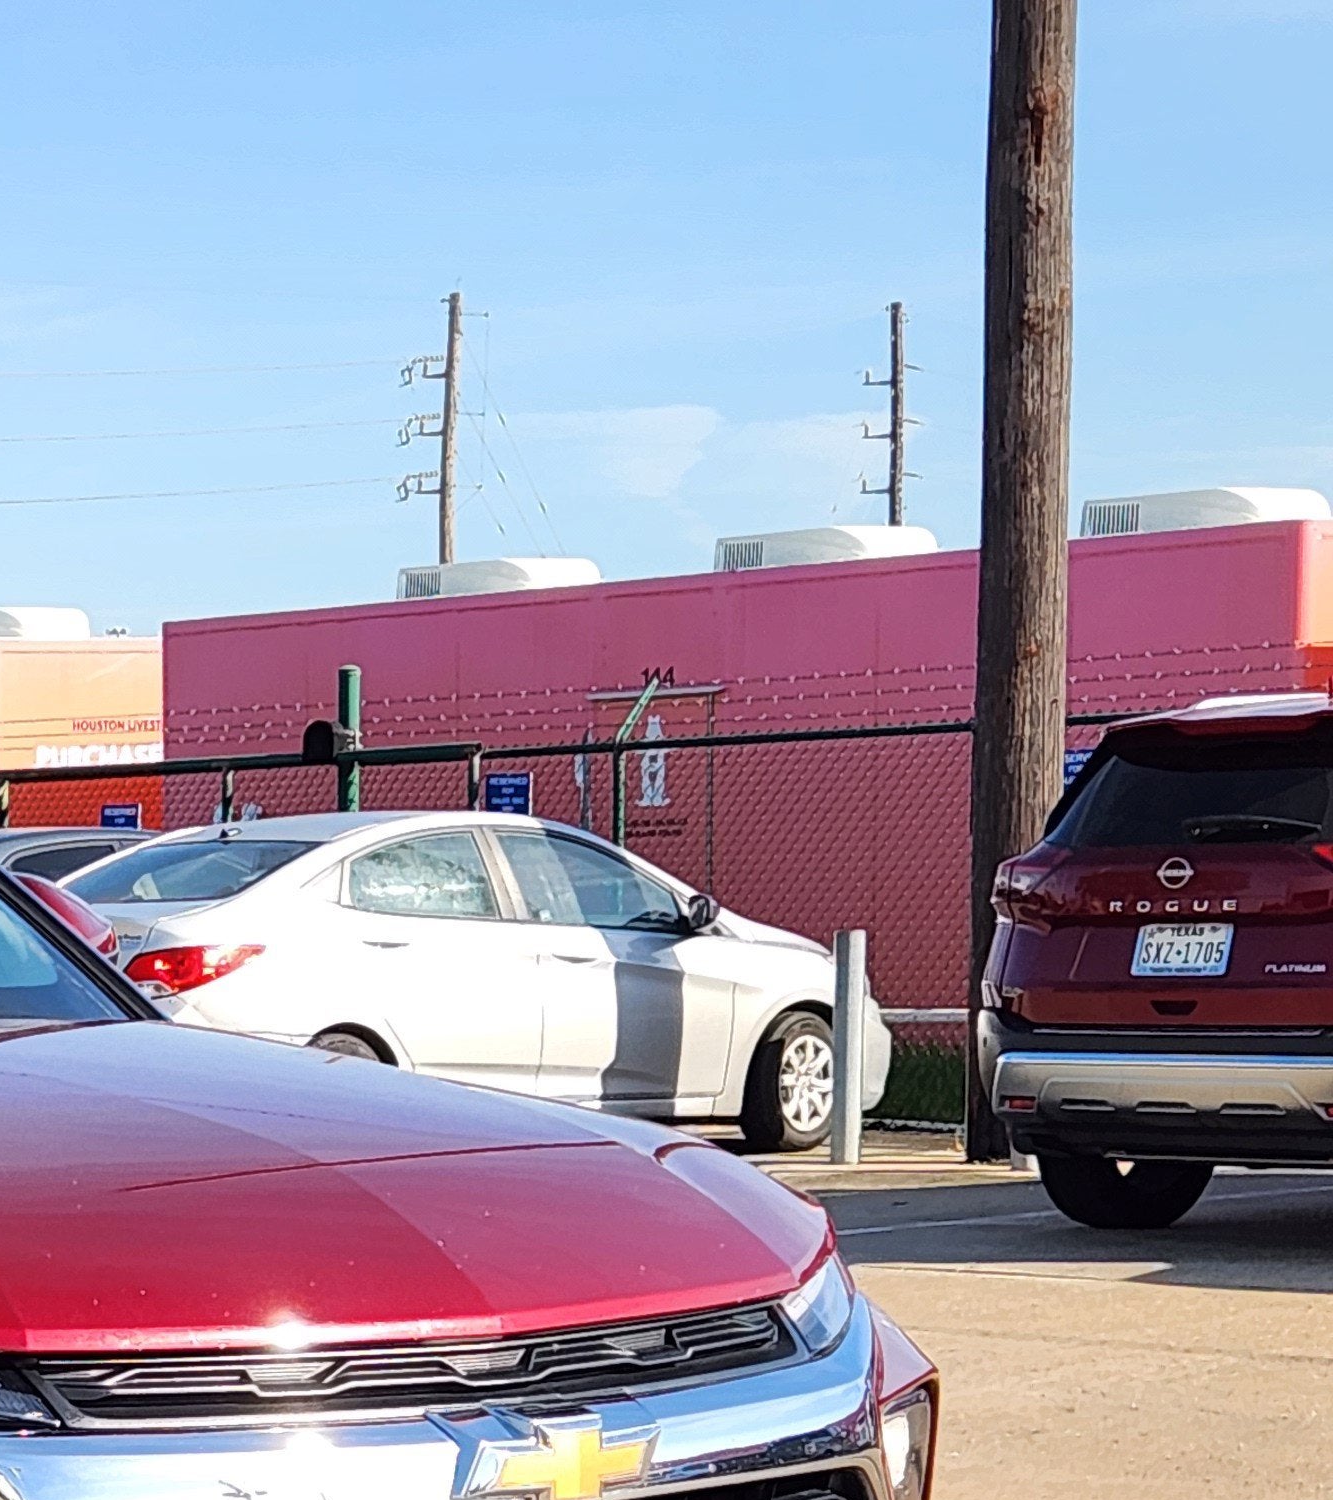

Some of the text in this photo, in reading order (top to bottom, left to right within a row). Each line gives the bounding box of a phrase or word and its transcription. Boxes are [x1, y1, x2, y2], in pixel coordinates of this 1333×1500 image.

[72, 719, 124, 732] HOUSTON
[1109, 900, 1238, 912] ROGUE
[1171, 925, 1205, 936] TEXAS
[1264, 964, 1326, 973] PLATINUM
